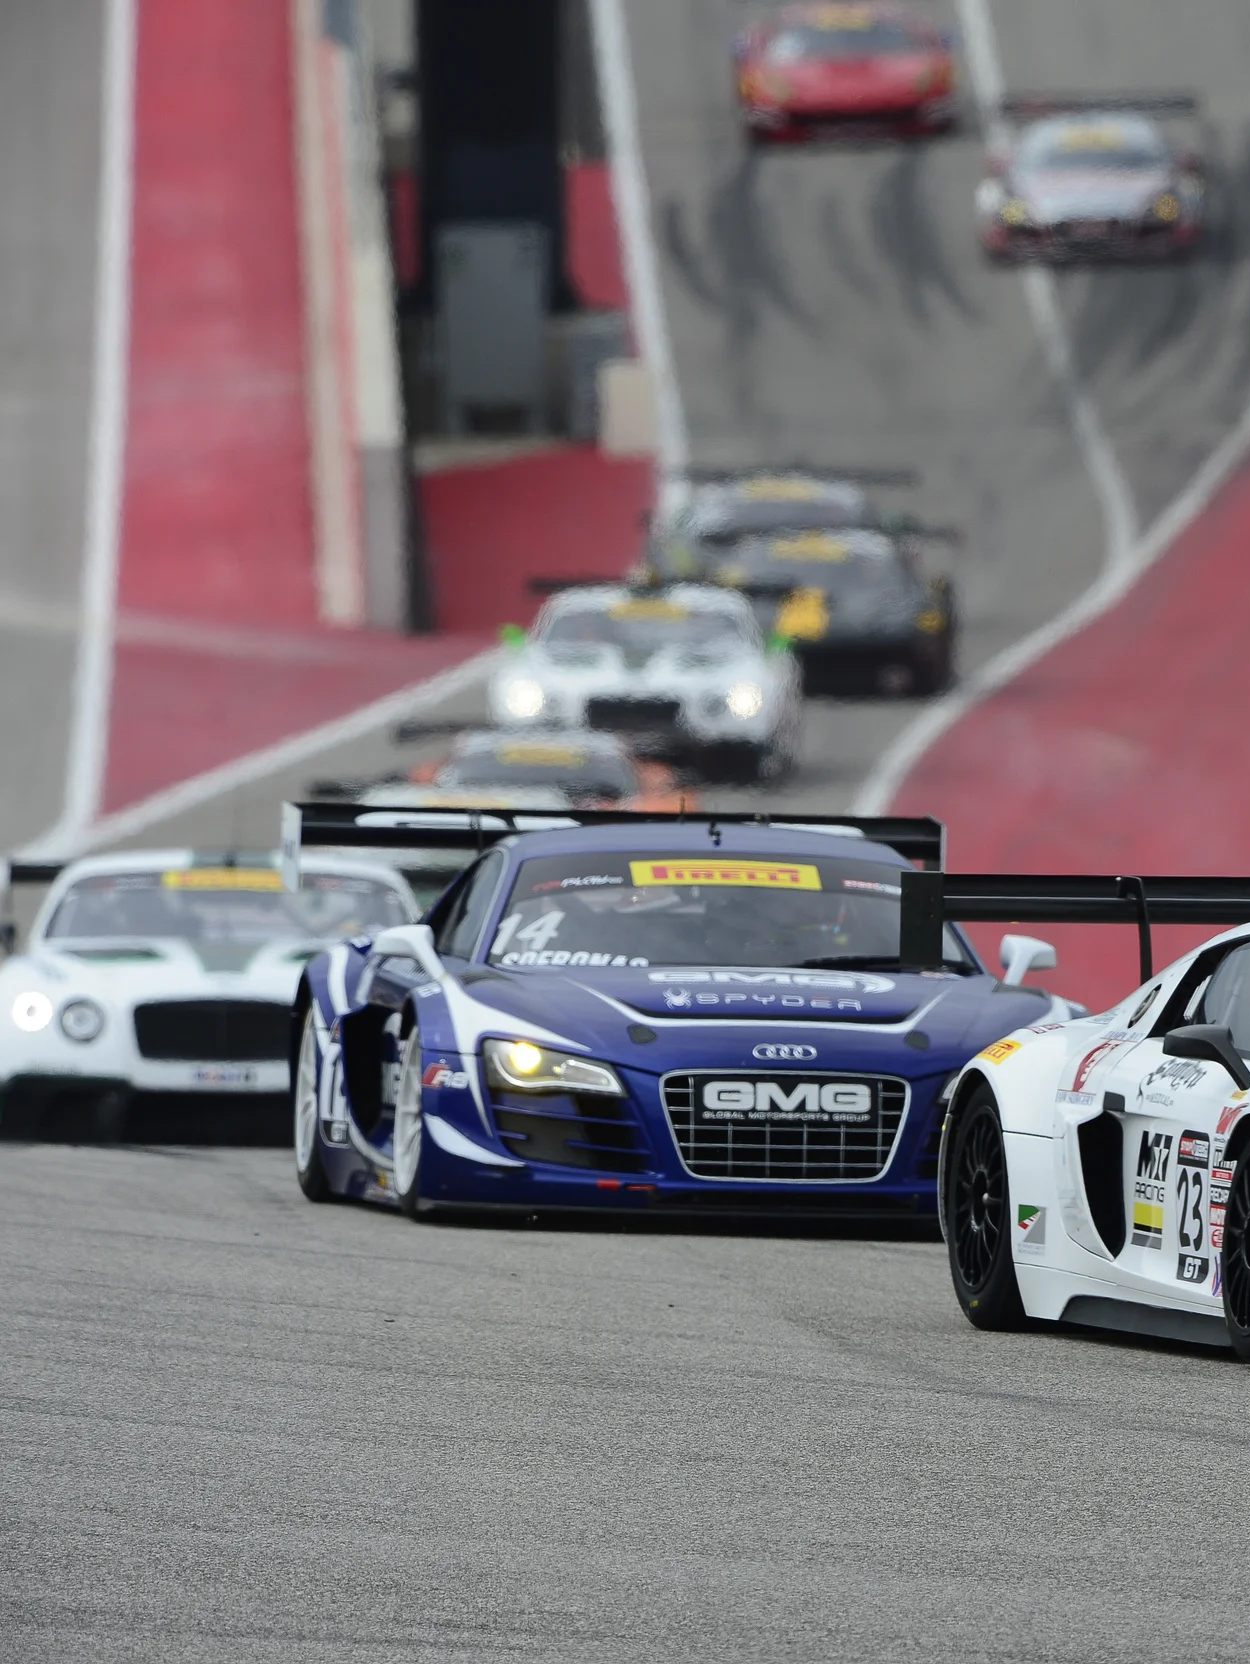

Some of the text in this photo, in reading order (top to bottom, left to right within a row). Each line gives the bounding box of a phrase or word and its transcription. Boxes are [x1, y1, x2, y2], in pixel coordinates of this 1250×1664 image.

[652, 864, 800, 883] PIRELLI
[490, 910, 566, 955] 14
[695, 992, 863, 1012] SPYDER
[703, 1081, 872, 1113] GMG
[702, 1111, 871, 1122] GLOBAL MOTORSPORTS GROUP
[1134, 1182, 1165, 1203] RACING
[1177, 1167, 1203, 1251] 23
[1183, 1257, 1202, 1279] GT
